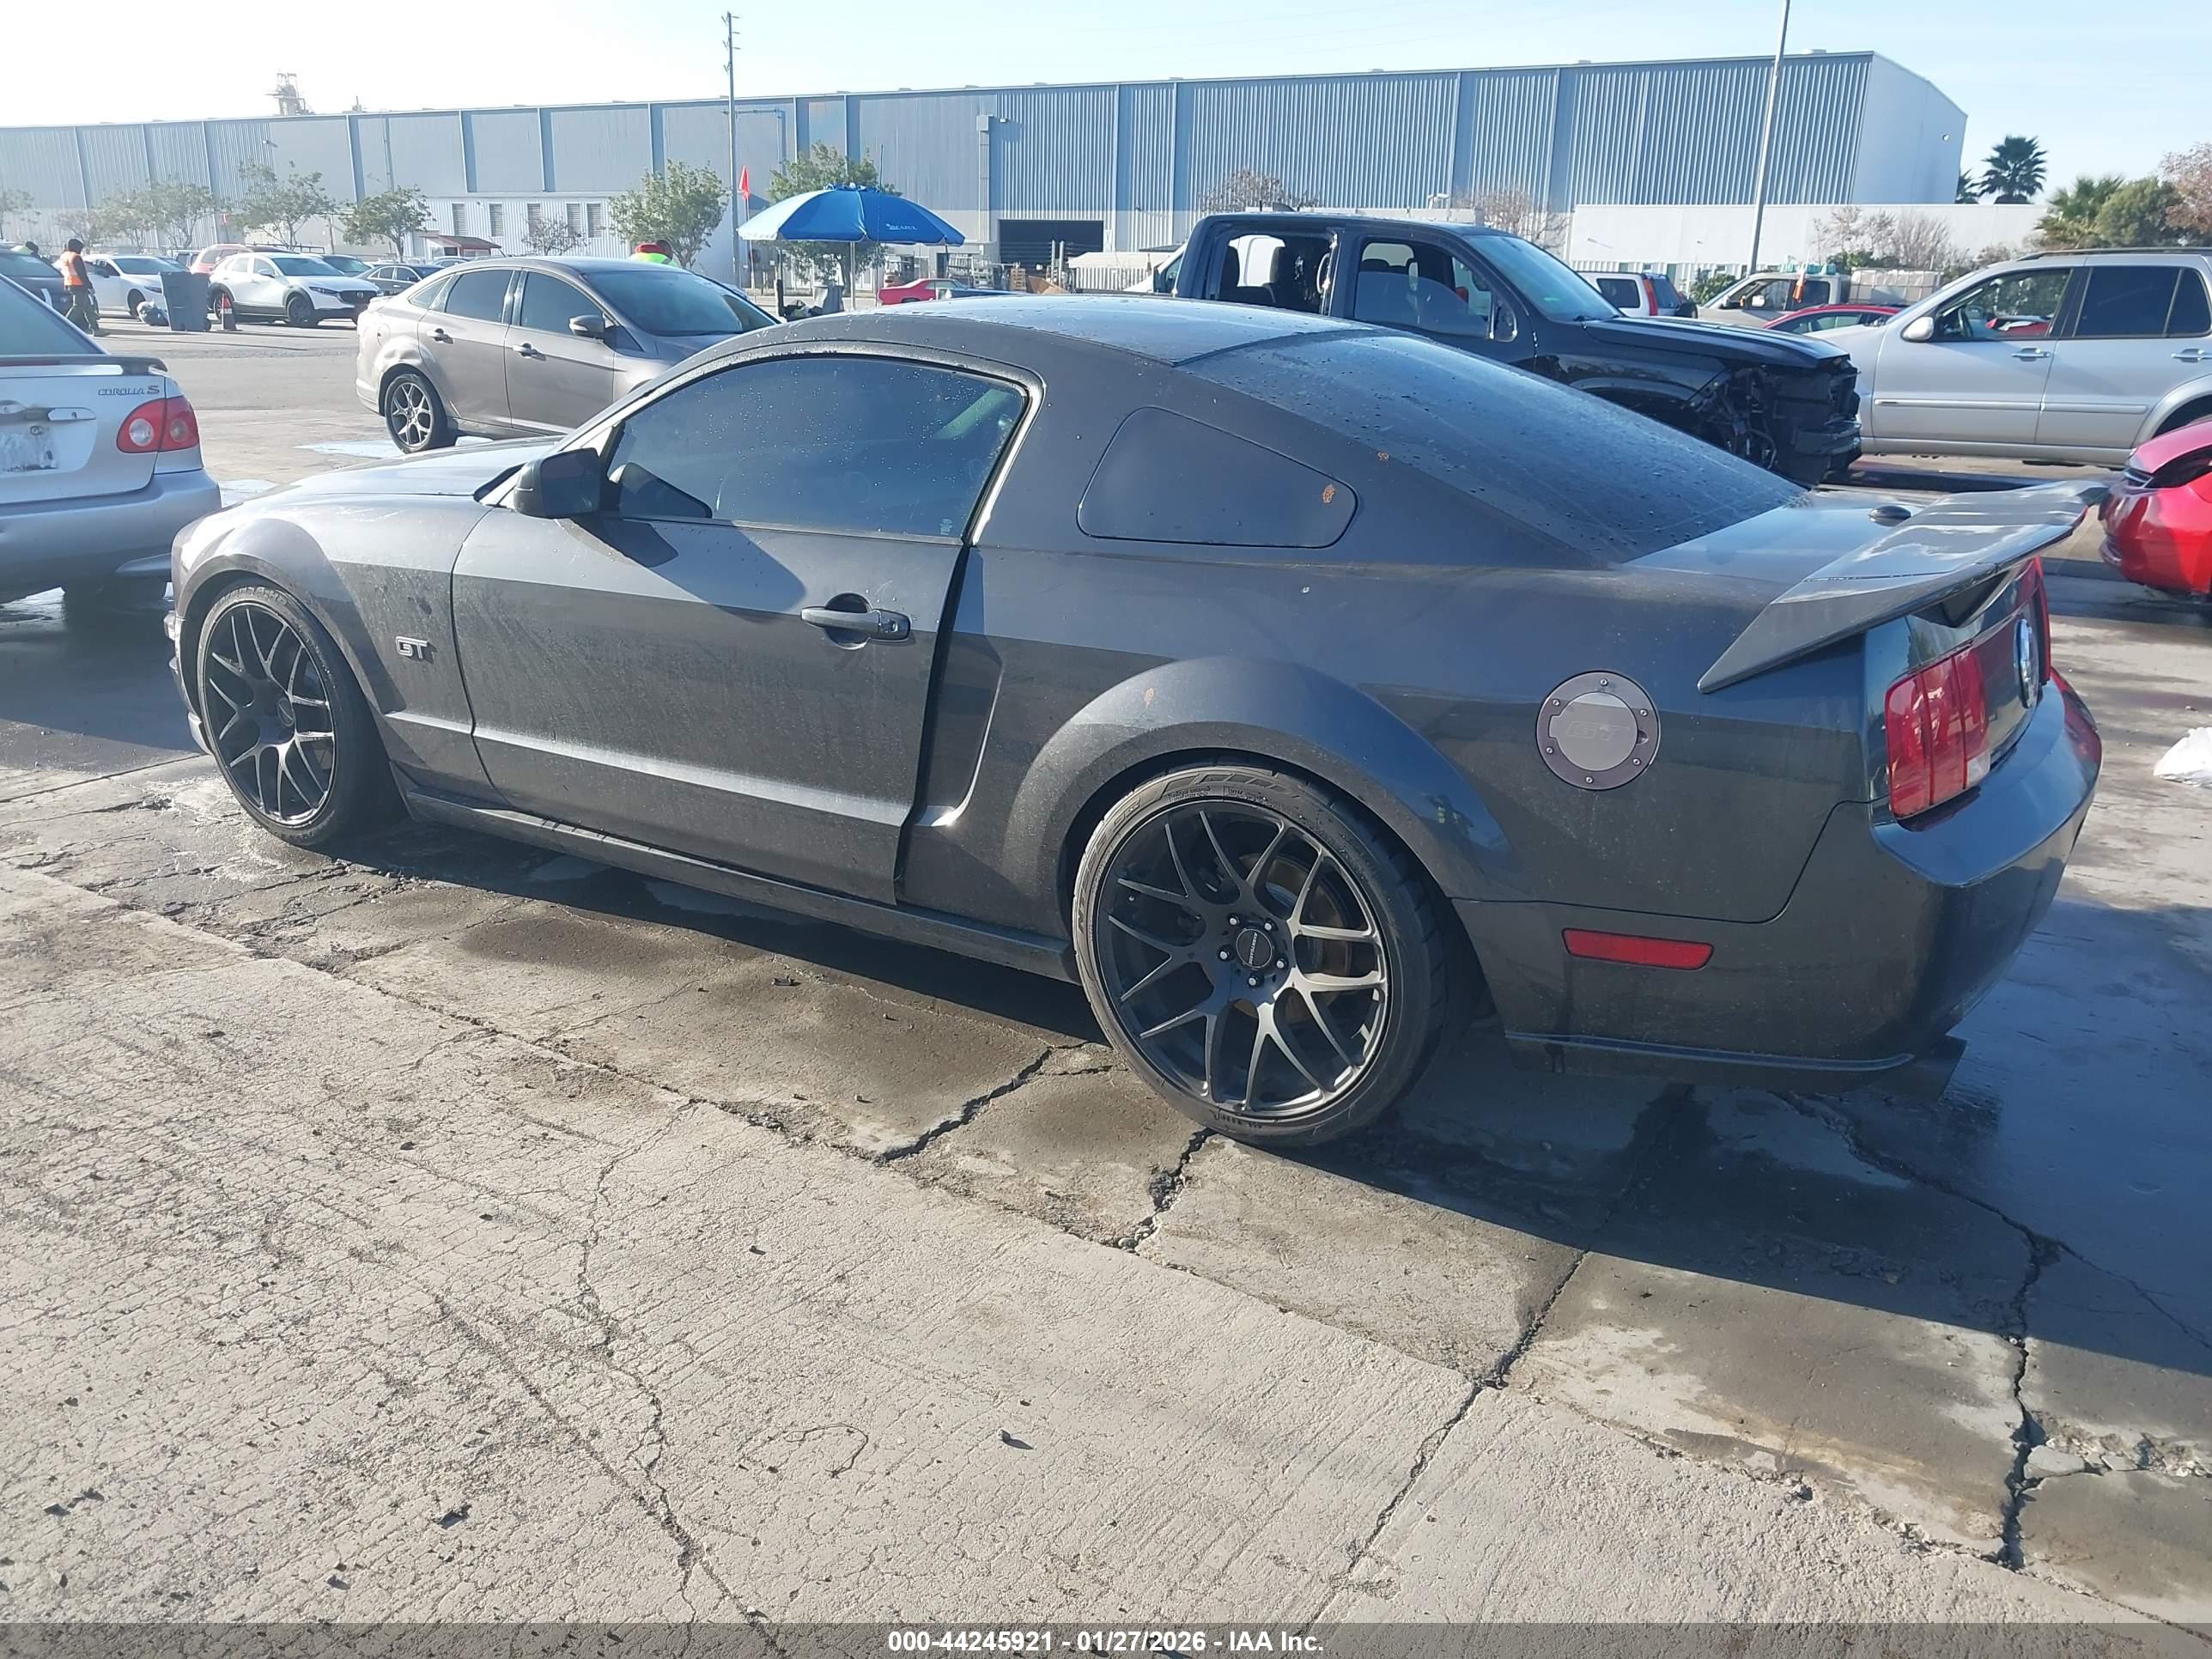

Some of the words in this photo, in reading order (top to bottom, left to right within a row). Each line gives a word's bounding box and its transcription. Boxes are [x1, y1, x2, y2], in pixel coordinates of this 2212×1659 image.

[98, 387, 145, 396] COROLLA
[147, 385, 160, 395] S
[396, 635, 428, 659] GT
[1565, 721, 1629, 742] GT
